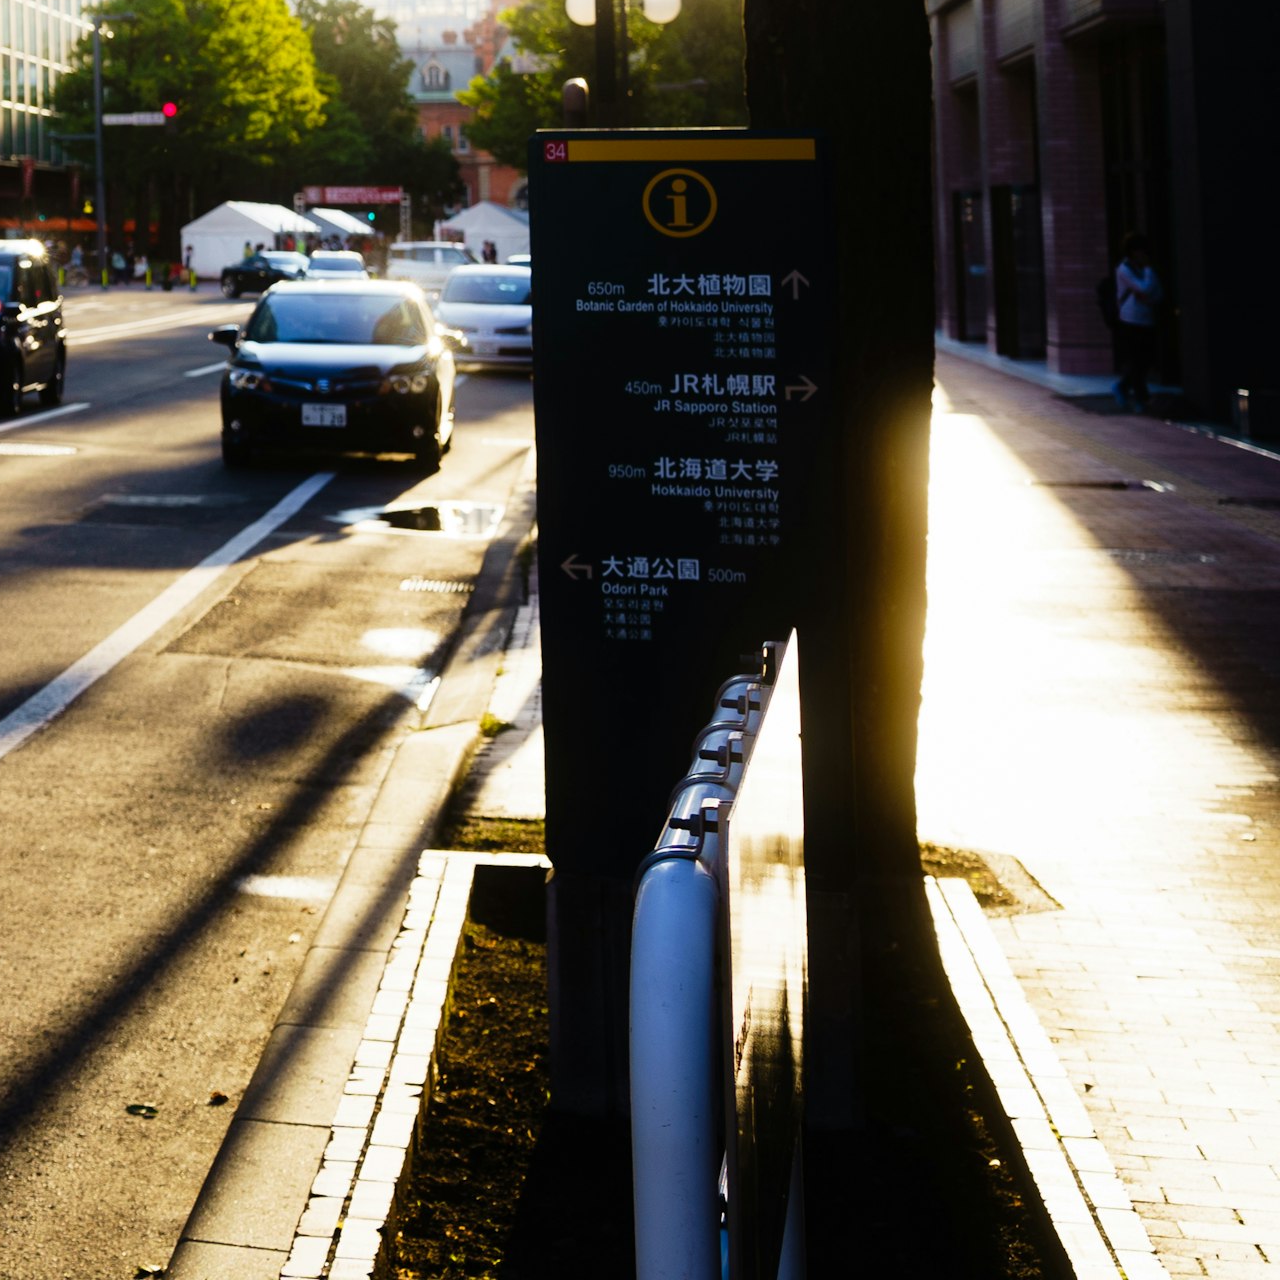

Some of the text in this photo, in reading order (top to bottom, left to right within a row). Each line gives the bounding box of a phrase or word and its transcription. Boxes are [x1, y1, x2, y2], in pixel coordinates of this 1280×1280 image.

[545, 144, 567, 160] 34
[587, 281, 625, 296] 650m
[647, 273, 773, 297] 北大植物園
[576, 299, 774, 316] Botanic Garden of Hokkaido University
[624, 381, 662, 395] 450m
[670, 373, 777, 397] JR札幌駅
[653, 400, 777, 415] JR Sapporo Station
[608, 464, 646, 479] 950m
[653, 456, 780, 482] 北海道大学
[651, 484, 780, 502] Hokkaido University
[601, 556, 701, 581] 大通公園
[707, 569, 747, 583] 500m
[601, 583, 669, 597] Odori Park
